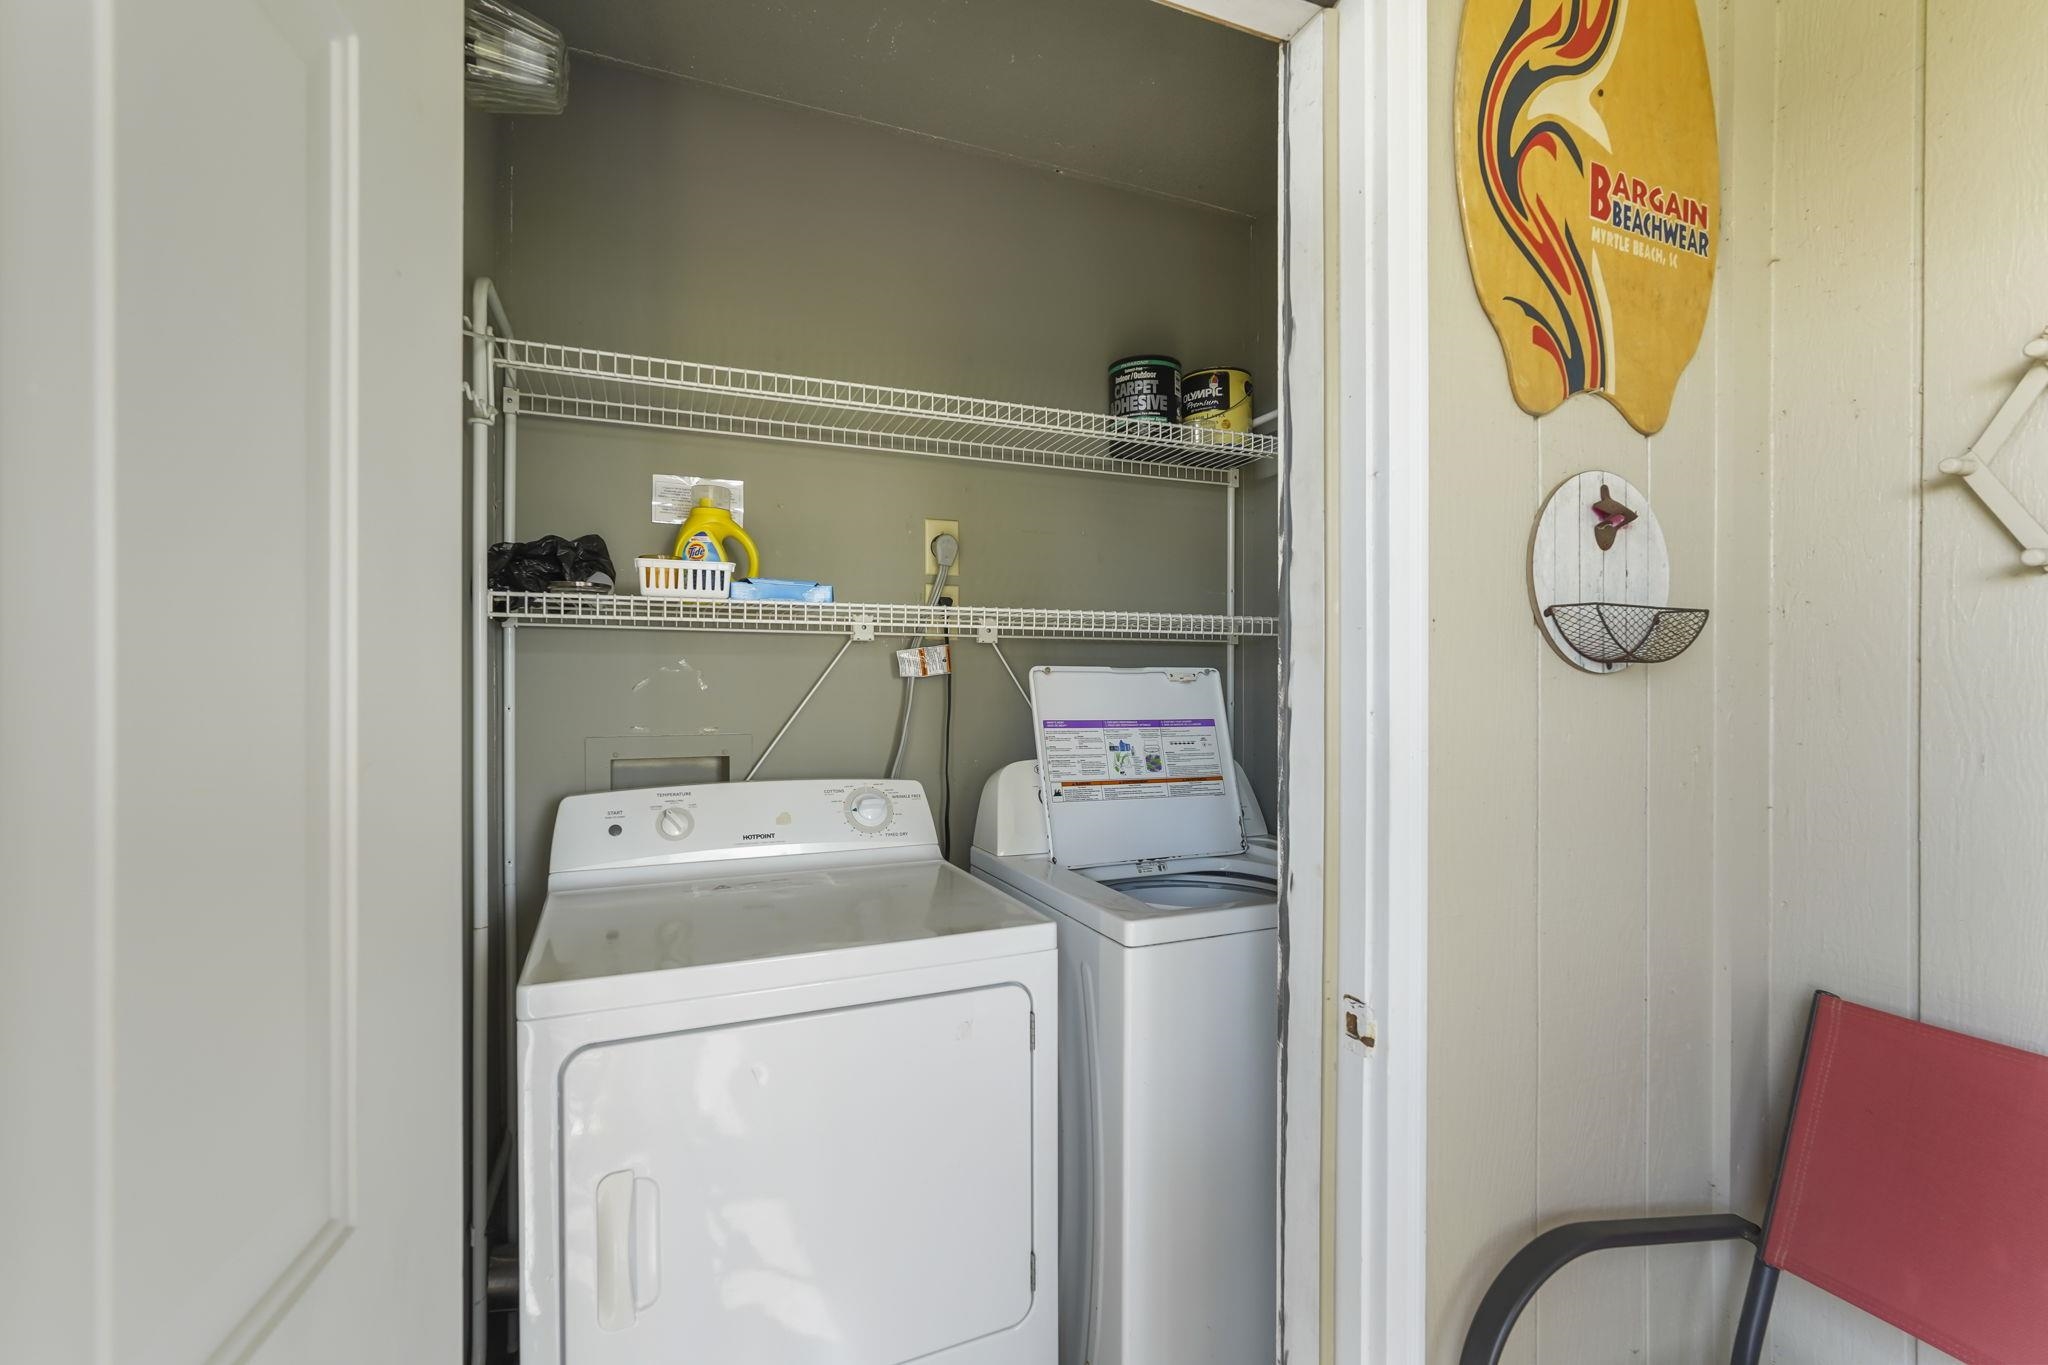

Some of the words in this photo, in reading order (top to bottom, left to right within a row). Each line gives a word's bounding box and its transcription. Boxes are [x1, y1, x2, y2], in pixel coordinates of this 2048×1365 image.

[1590, 161, 1709, 231] BARGAIN
[1611, 200, 1710, 258] BEACHWEAR
[1591, 226, 1630, 253] MYRTLE
[1633, 240, 1666, 266] BEACH,
[1669, 252, 1678, 269] SC
[1114, 379, 1159, 399] CARPET
[1183, 386, 1223, 403] OLYMPIC
[1186, 400, 1219, 410] Premium
[688, 546, 705, 559] Tide
[742, 832, 775, 841] HOTPOINT
